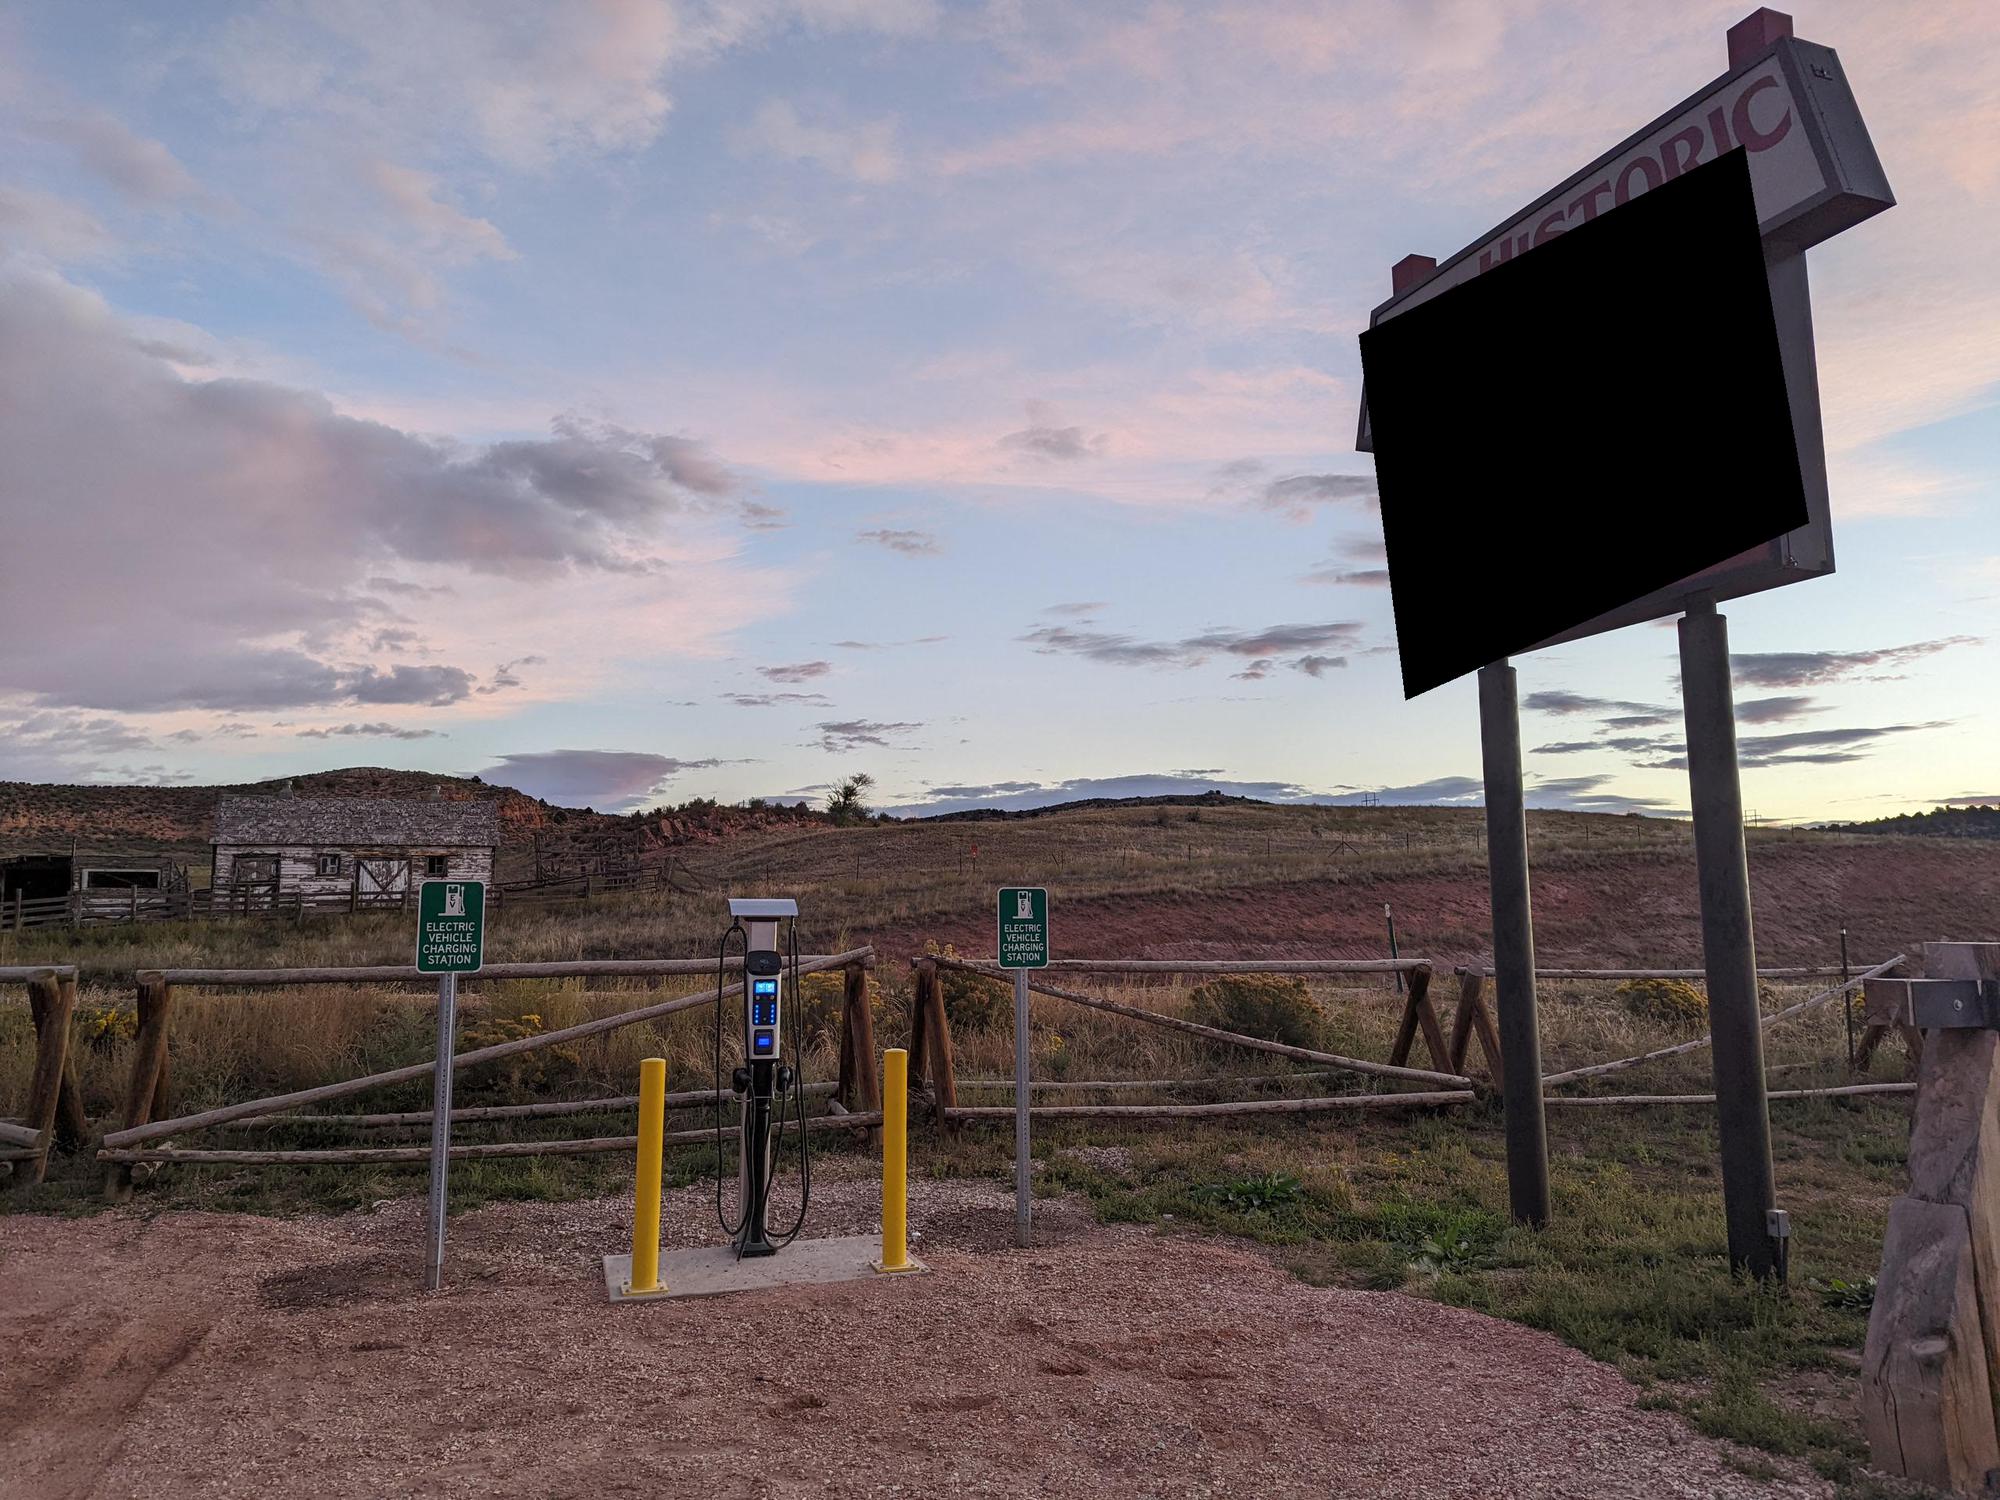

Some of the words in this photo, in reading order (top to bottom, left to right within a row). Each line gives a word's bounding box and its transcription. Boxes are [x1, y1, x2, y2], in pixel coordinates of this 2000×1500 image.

[449, 894, 456, 908] EV
[426, 922, 475, 932] ELECTRIC
[1004, 924, 1042, 933] ELECTRIC
[428, 933, 473, 943] VEHICLE
[1006, 933, 1040, 942] VEHICLE
[422, 944, 477, 954] CHARGING
[1002, 943, 1044, 952] CHARGING
[428, 954, 471, 964] STATION
[1007, 952, 1040, 961] STATION
